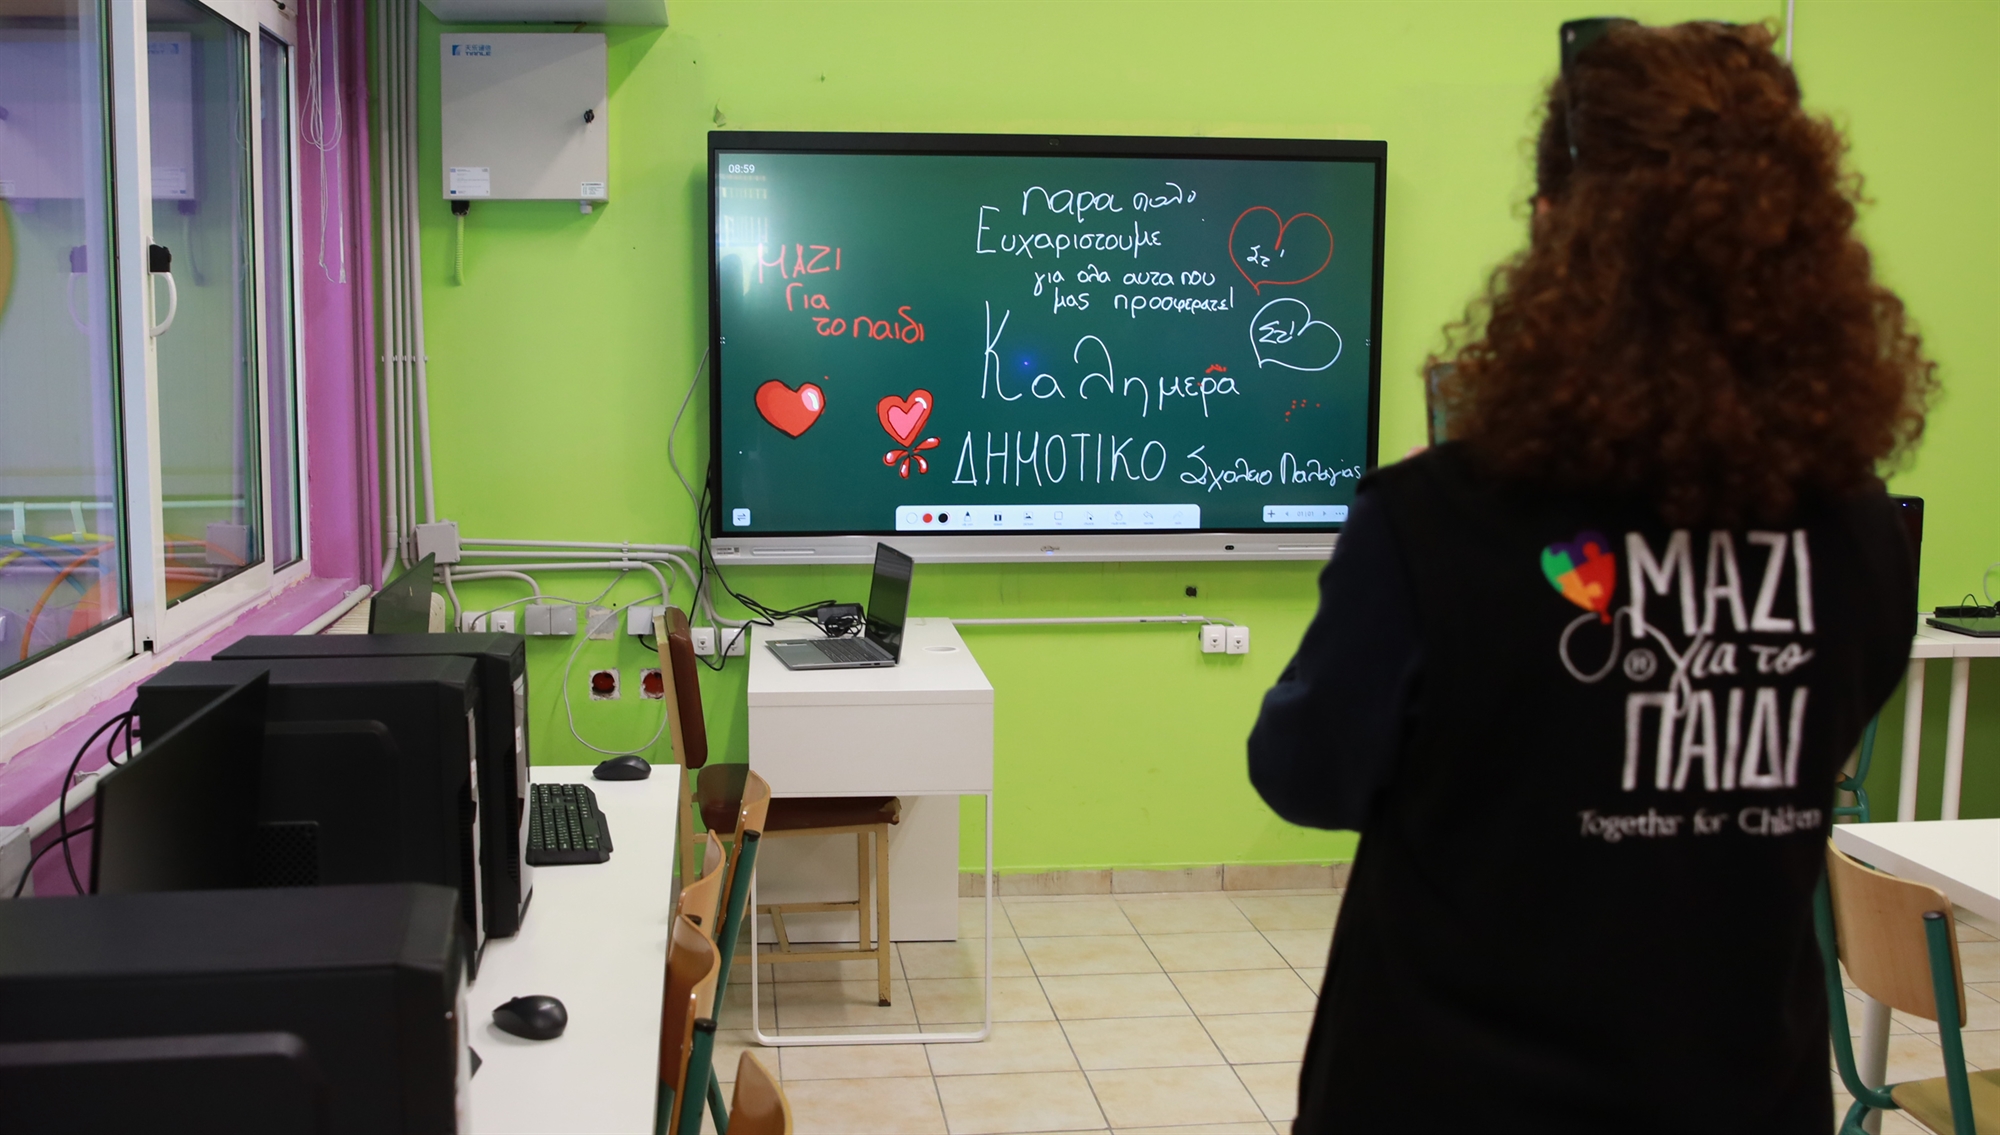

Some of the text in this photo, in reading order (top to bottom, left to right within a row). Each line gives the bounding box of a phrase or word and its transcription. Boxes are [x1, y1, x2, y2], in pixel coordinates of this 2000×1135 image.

[728, 164, 755, 174] 08:59
[976, 205, 1162, 259] Ευχαριστουμε
[757, 243, 841, 284] ΜΑΖΙ
[1033, 263, 1216, 297] για ολα αυτα που
[1053, 286, 1090, 315] μας
[812, 316, 847, 337] το
[952, 430, 1167, 487] ΔΗΜΟΤΙΚΟ
[1626, 529, 1816, 638] ΜΑΖΙ
[1646, 624, 1816, 718] για το
[1621, 686, 1808, 791] ΠΑΙΔΙ
[1693, 808, 1729, 835] for
